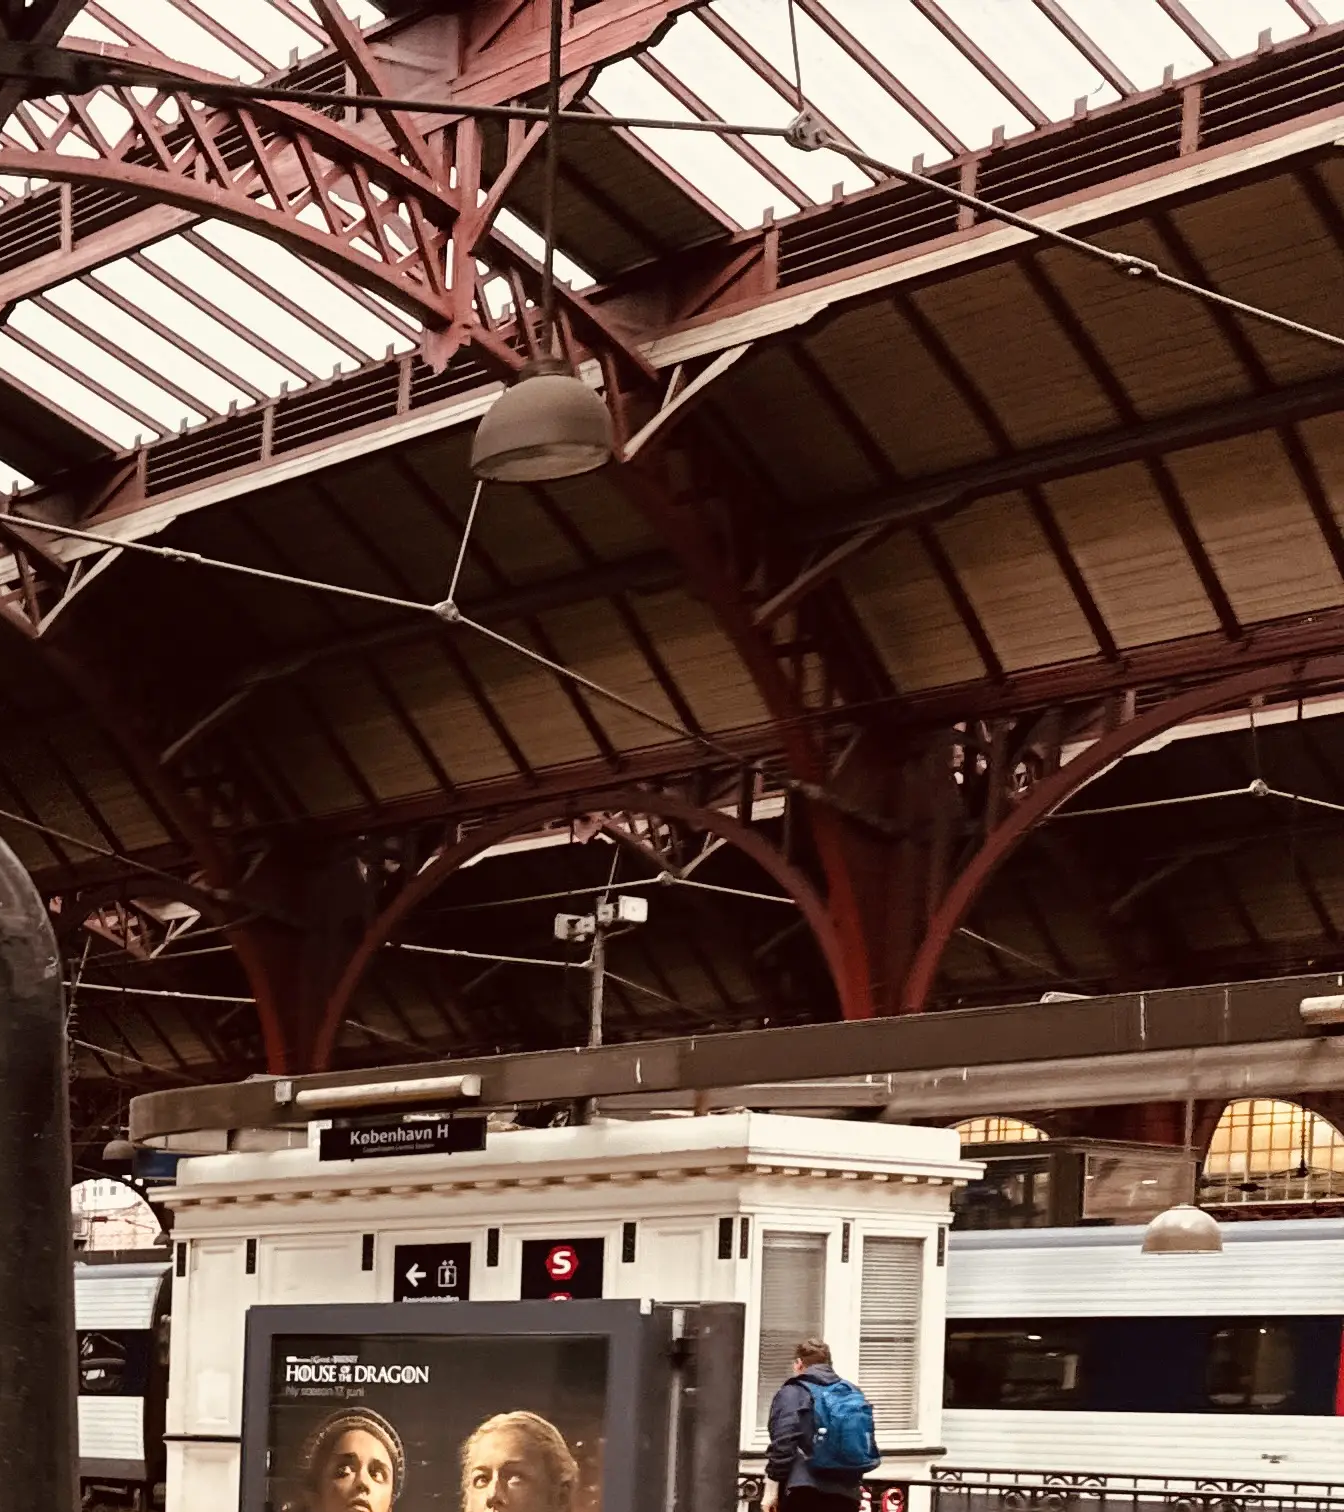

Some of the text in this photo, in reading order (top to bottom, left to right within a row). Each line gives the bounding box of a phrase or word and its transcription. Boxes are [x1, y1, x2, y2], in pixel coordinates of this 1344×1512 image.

[350, 1123, 449, 1146] København H
[551, 1250, 572, 1275] S
[285, 1364, 337, 1383] HOUSE
[354, 1365, 430, 1384] DRAGON
